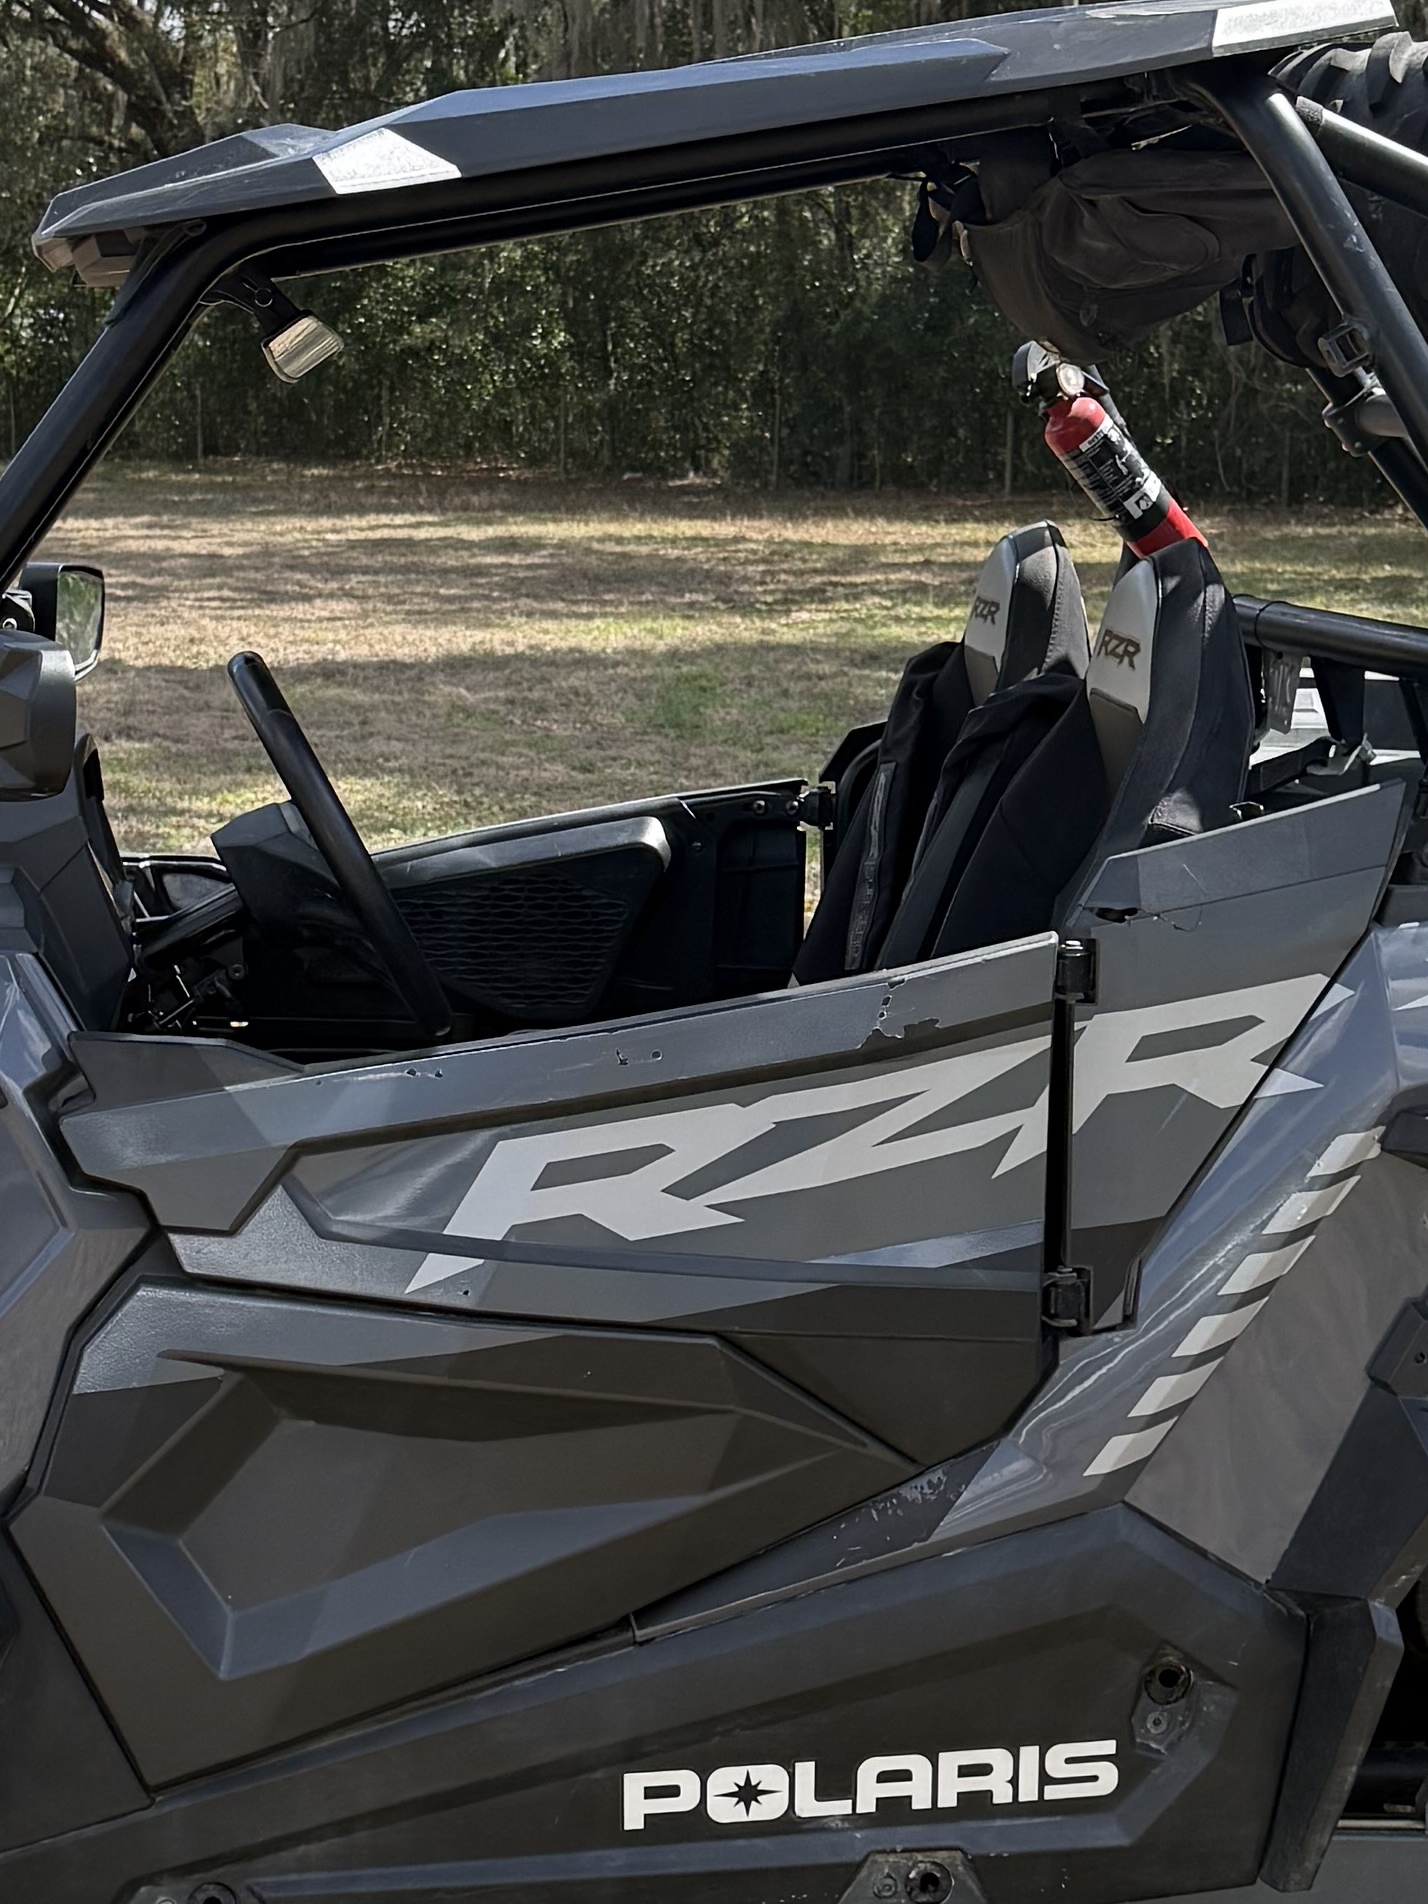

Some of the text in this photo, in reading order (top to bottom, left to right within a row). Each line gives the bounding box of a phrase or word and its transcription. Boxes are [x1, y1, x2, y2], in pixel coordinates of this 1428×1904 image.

[1097, 629, 1141, 670] RZR
[406, 972, 1353, 1293] RZR
[622, 1741, 1119, 1831] POLARIS
